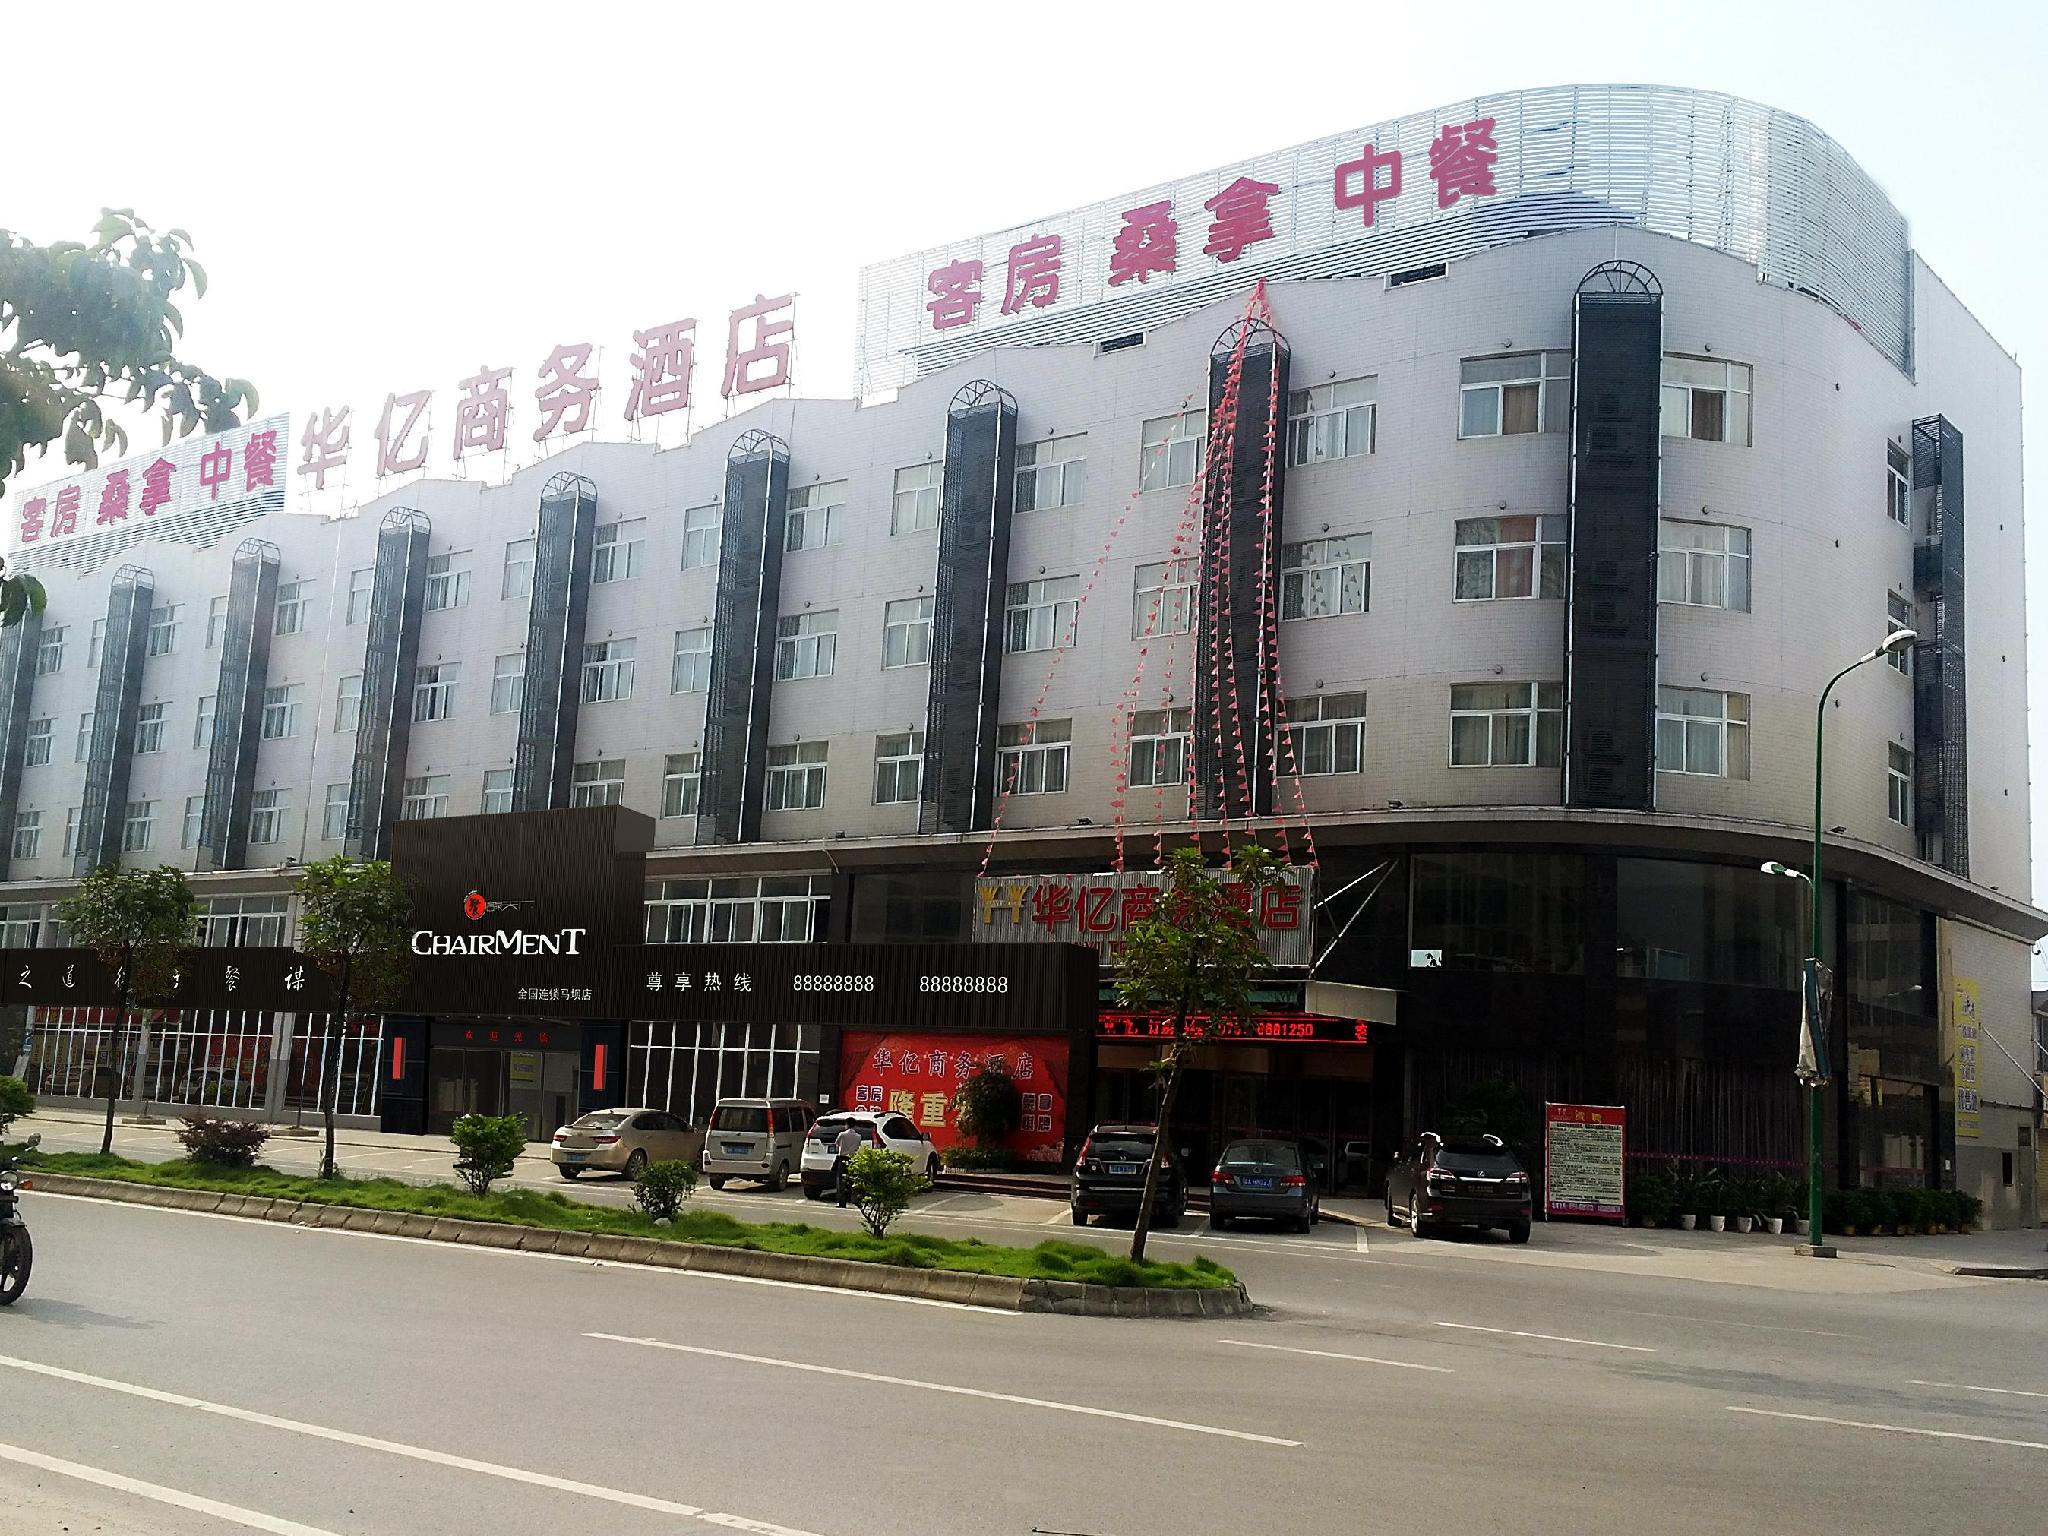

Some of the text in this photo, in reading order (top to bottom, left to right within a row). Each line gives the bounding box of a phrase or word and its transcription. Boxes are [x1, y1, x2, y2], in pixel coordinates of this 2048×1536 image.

[927, 118, 1498, 330] 客房 桑拿 中餐
[297, 293, 795, 489] 华亿商务酒店
[21, 431, 277, 542] 客房 桑拿 中餐
[517, 987, 593, 1001] 全国连锁马坝店
[646, 972, 1008, 993] 尊享热线 88888888 88888888
[856, 1085, 884, 1102] 客房
